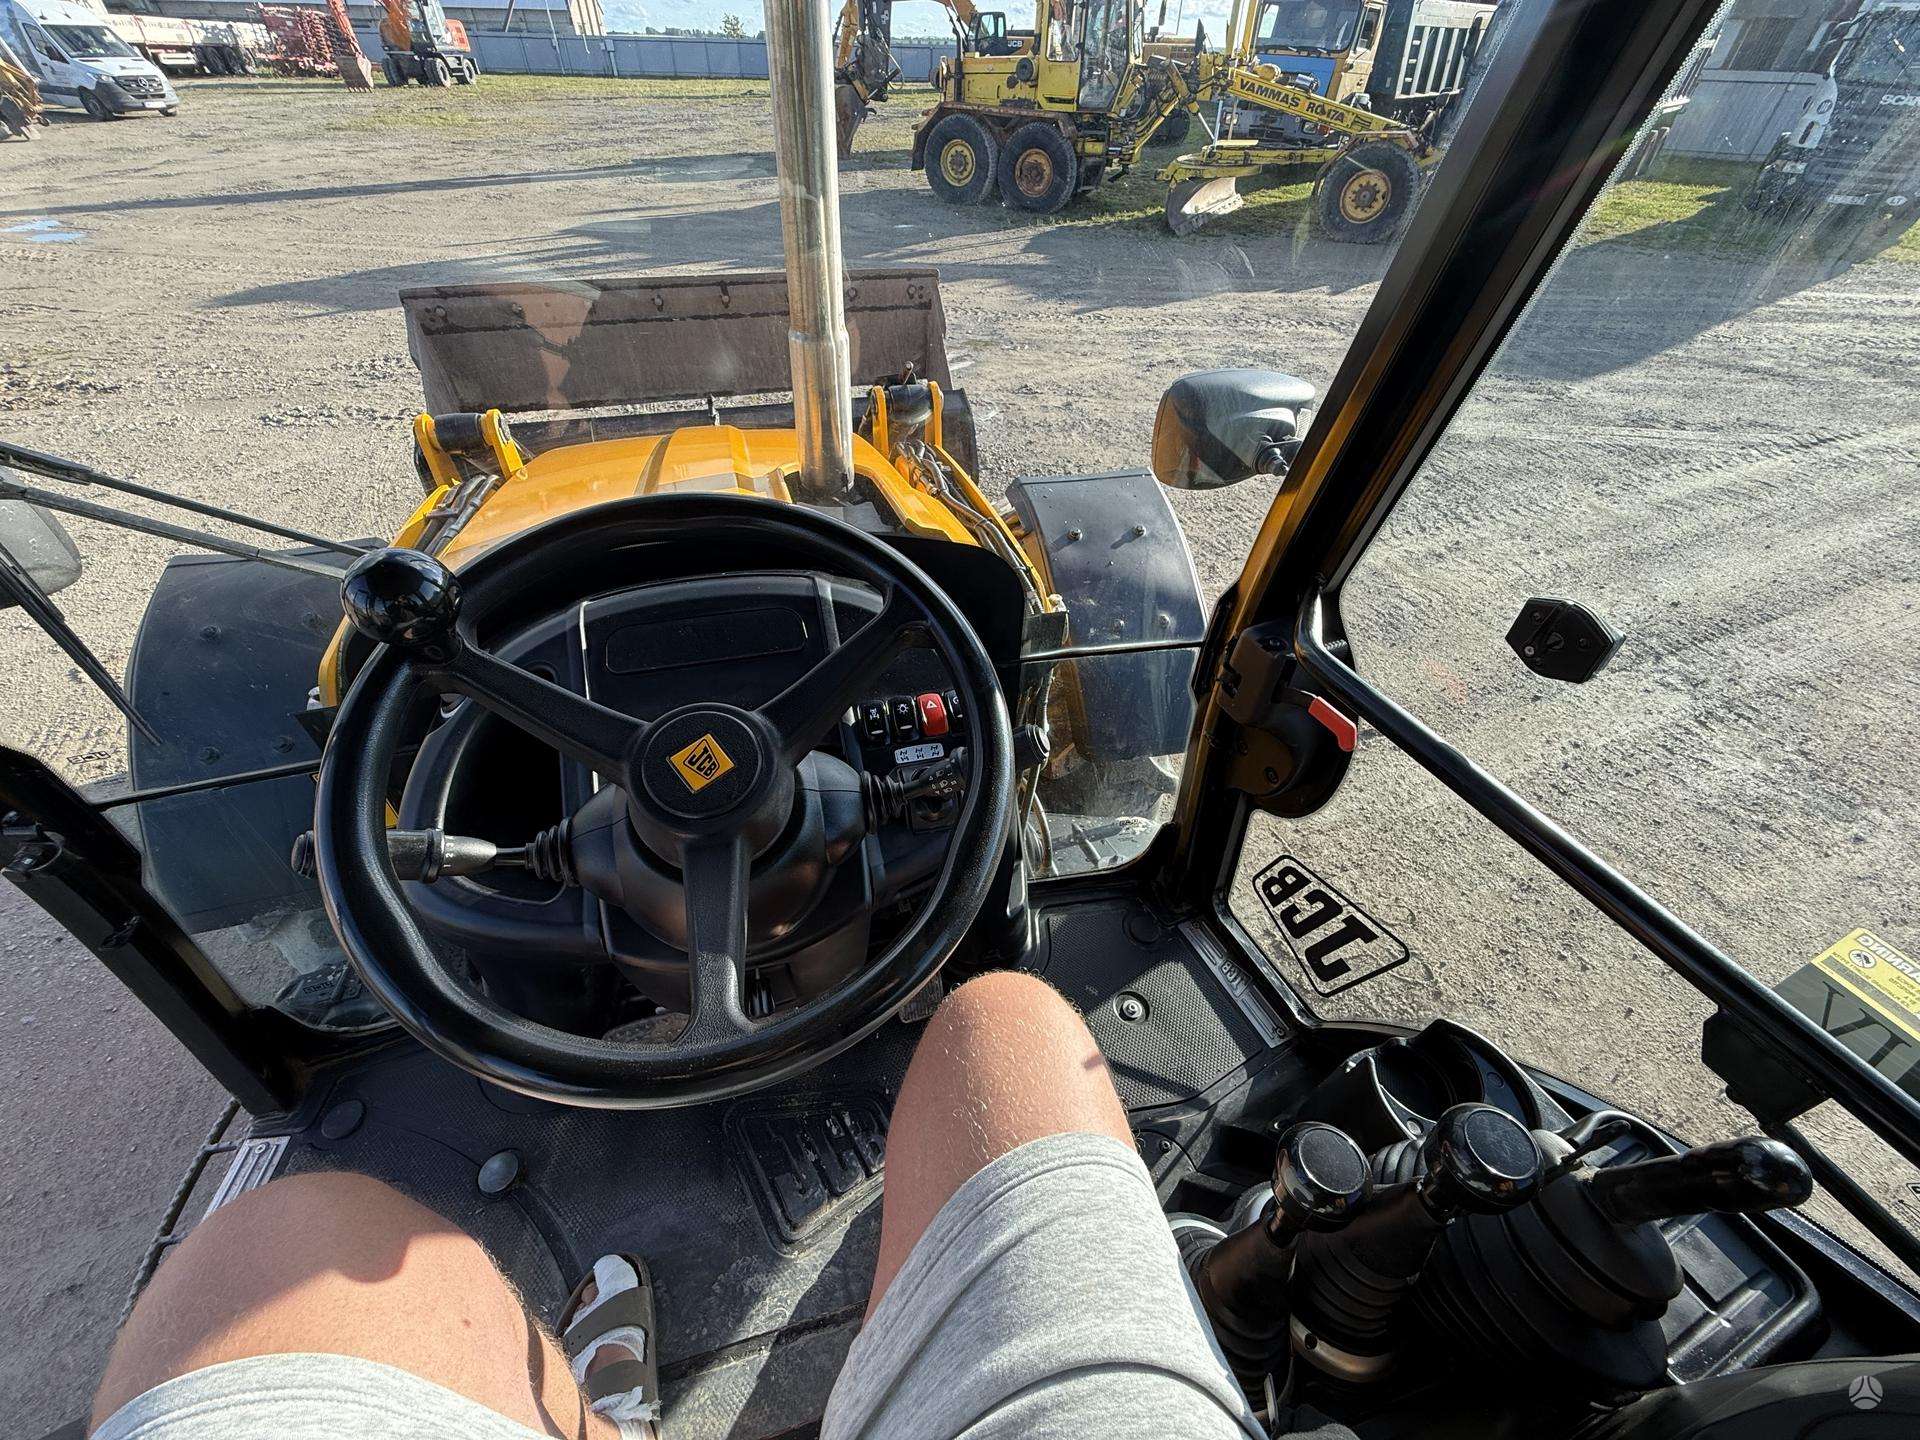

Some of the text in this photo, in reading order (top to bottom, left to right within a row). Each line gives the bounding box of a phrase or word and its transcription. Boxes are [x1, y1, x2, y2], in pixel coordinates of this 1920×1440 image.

[1240, 78, 1300, 107] VAMMAS
[687, 746, 717, 777] JCB
[1221, 961, 1247, 996] JCB
